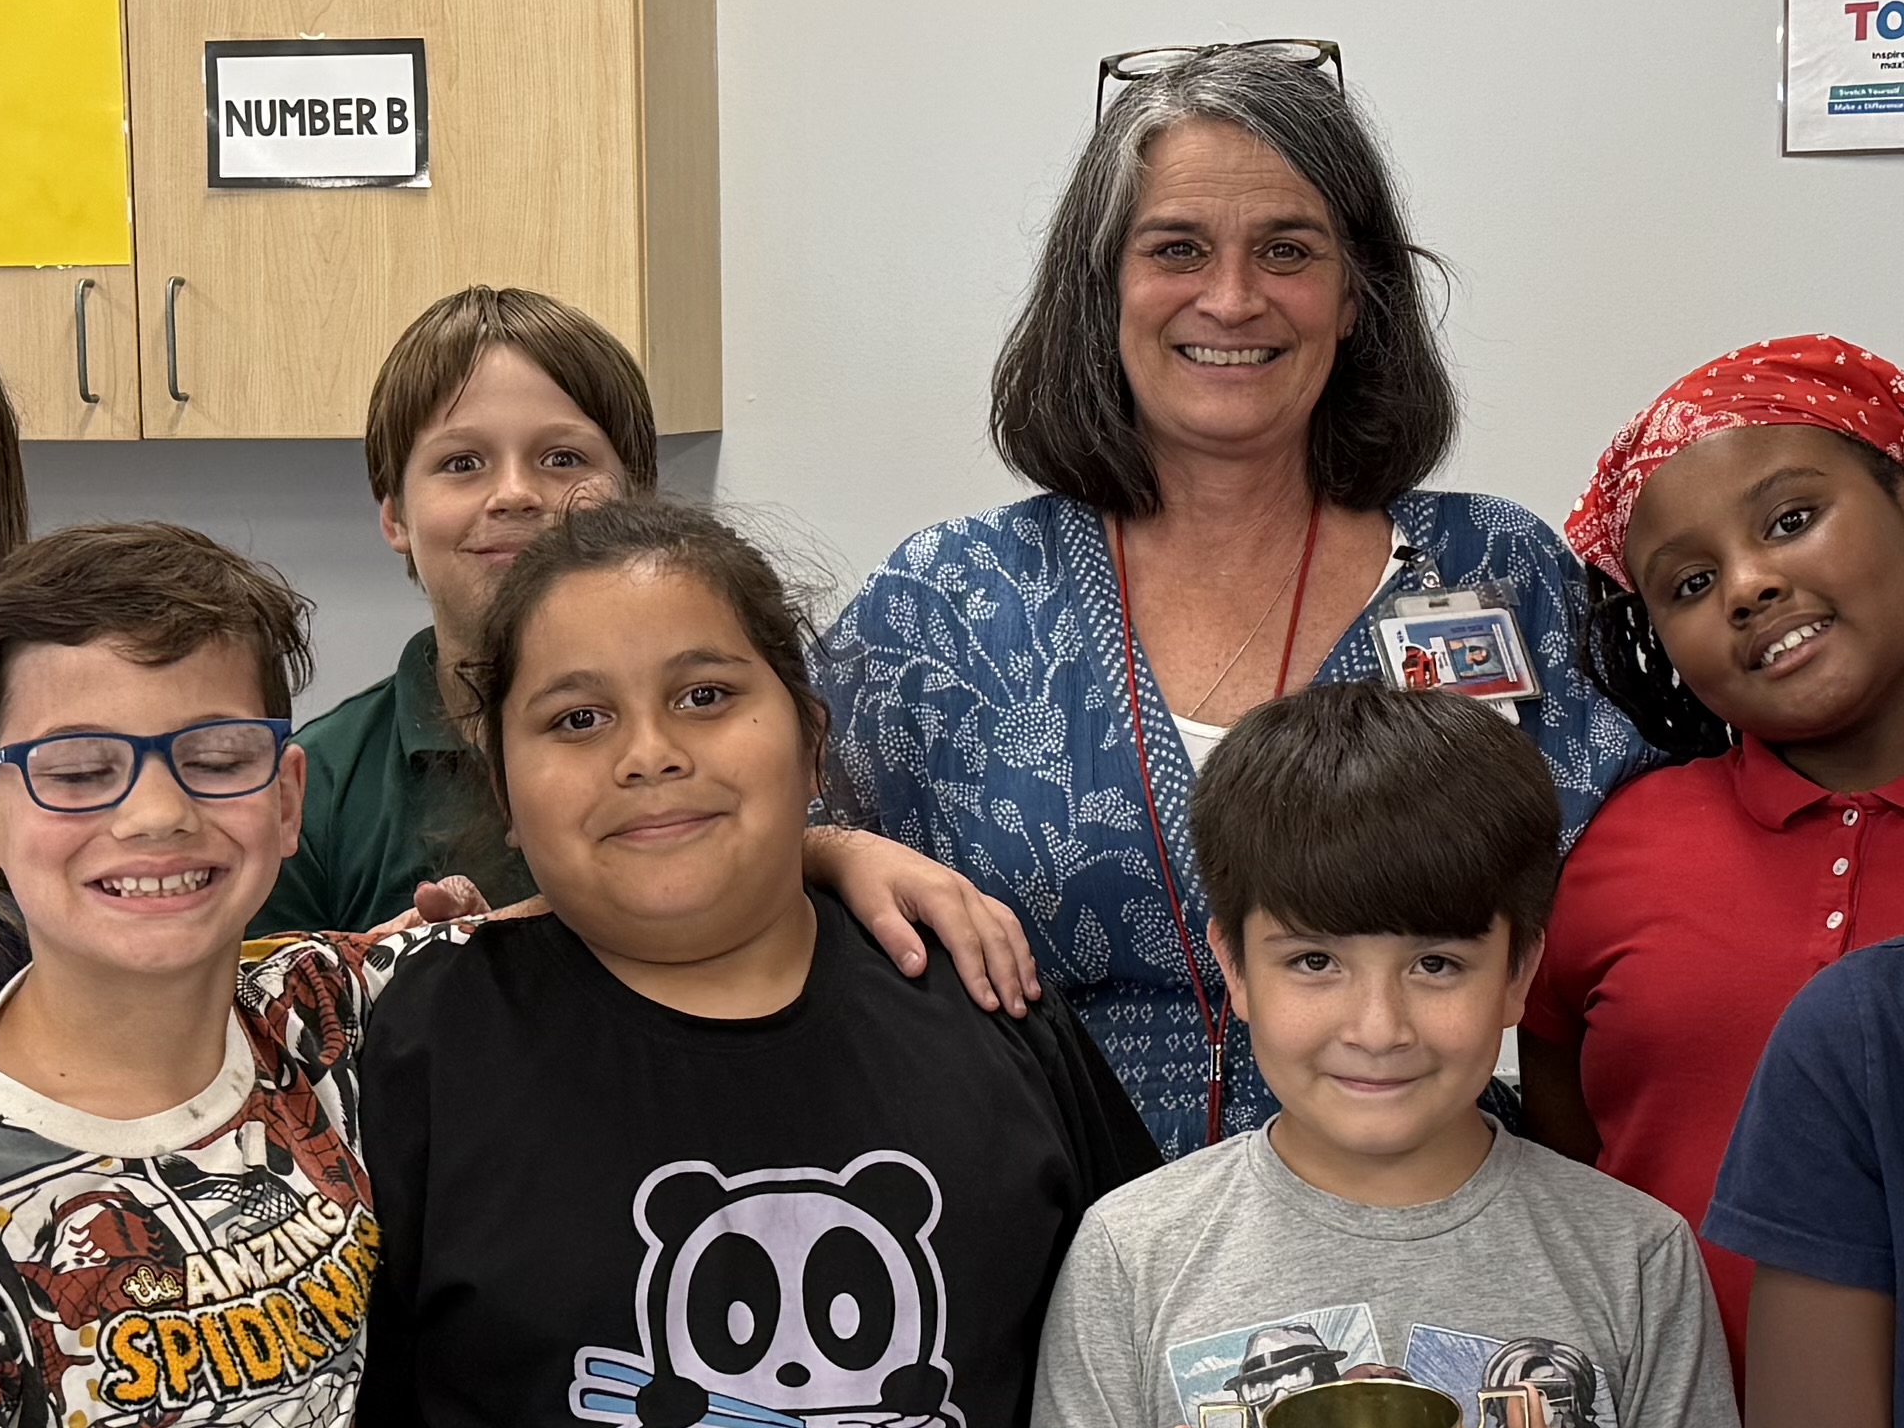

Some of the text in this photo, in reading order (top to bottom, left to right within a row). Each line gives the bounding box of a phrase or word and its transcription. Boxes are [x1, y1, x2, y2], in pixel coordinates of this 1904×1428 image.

[224, 96, 410, 138] NUMBER B
[123, 1264, 184, 1308] the
